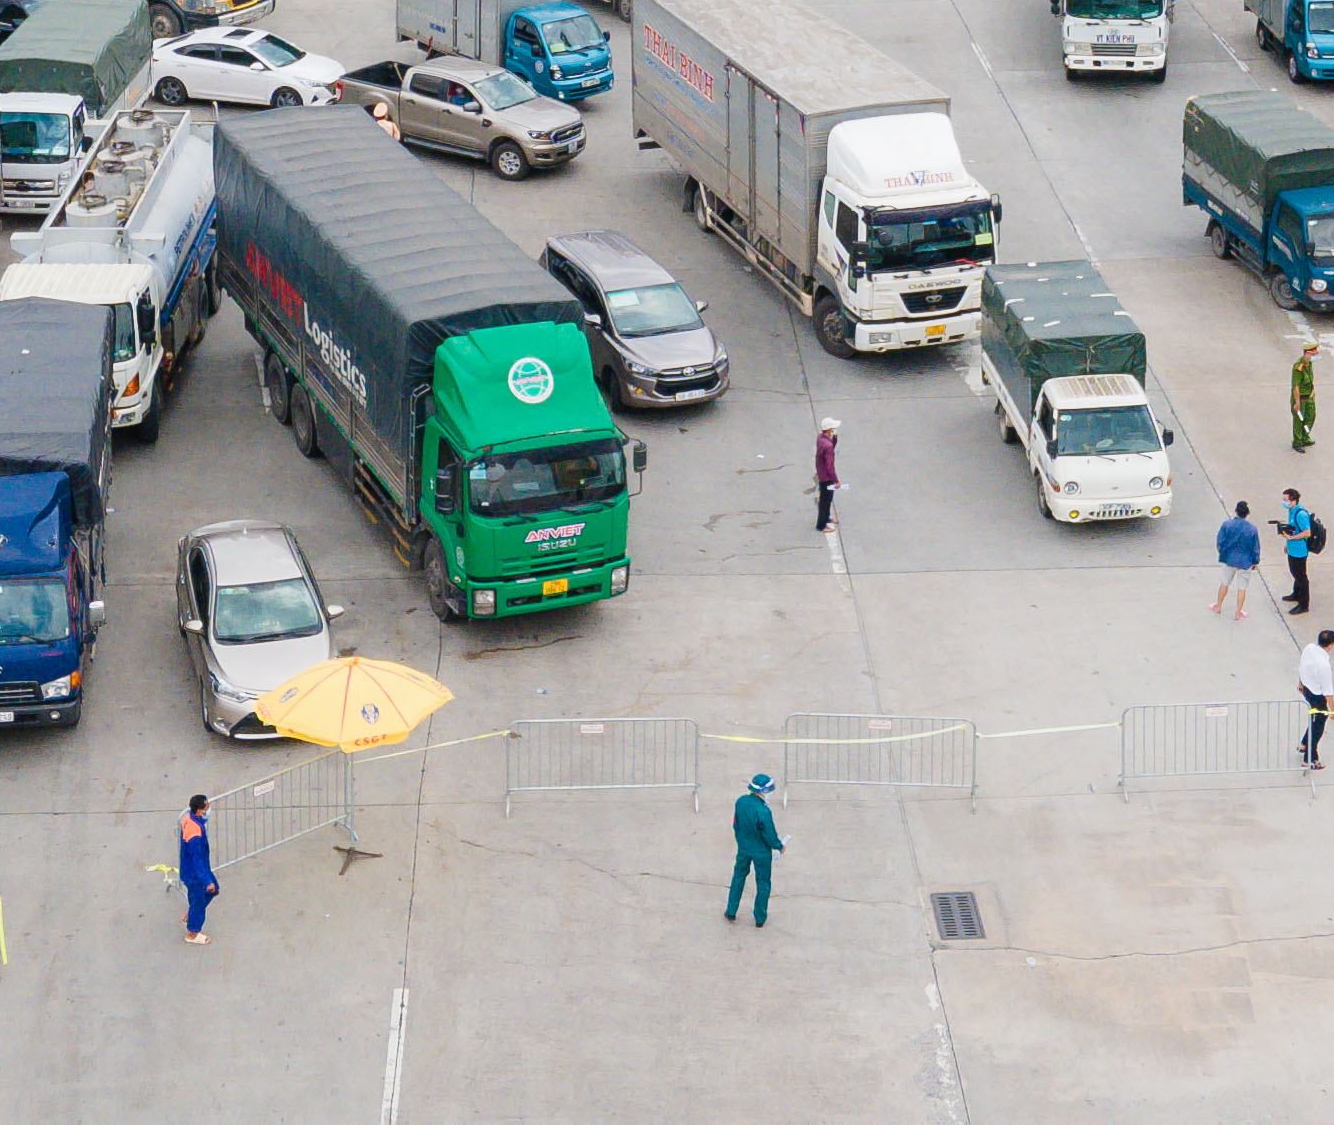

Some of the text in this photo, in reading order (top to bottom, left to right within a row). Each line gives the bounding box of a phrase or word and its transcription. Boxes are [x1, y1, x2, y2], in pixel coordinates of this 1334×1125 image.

[644, 24, 676, 71] THAI
[679, 52, 714, 100] BINH
[908, 278, 962, 290] DAEWOO
[303, 301, 367, 398] Logistics
[524, 522, 586, 543] ANVIET
[538, 538, 577, 551] ISUZU
